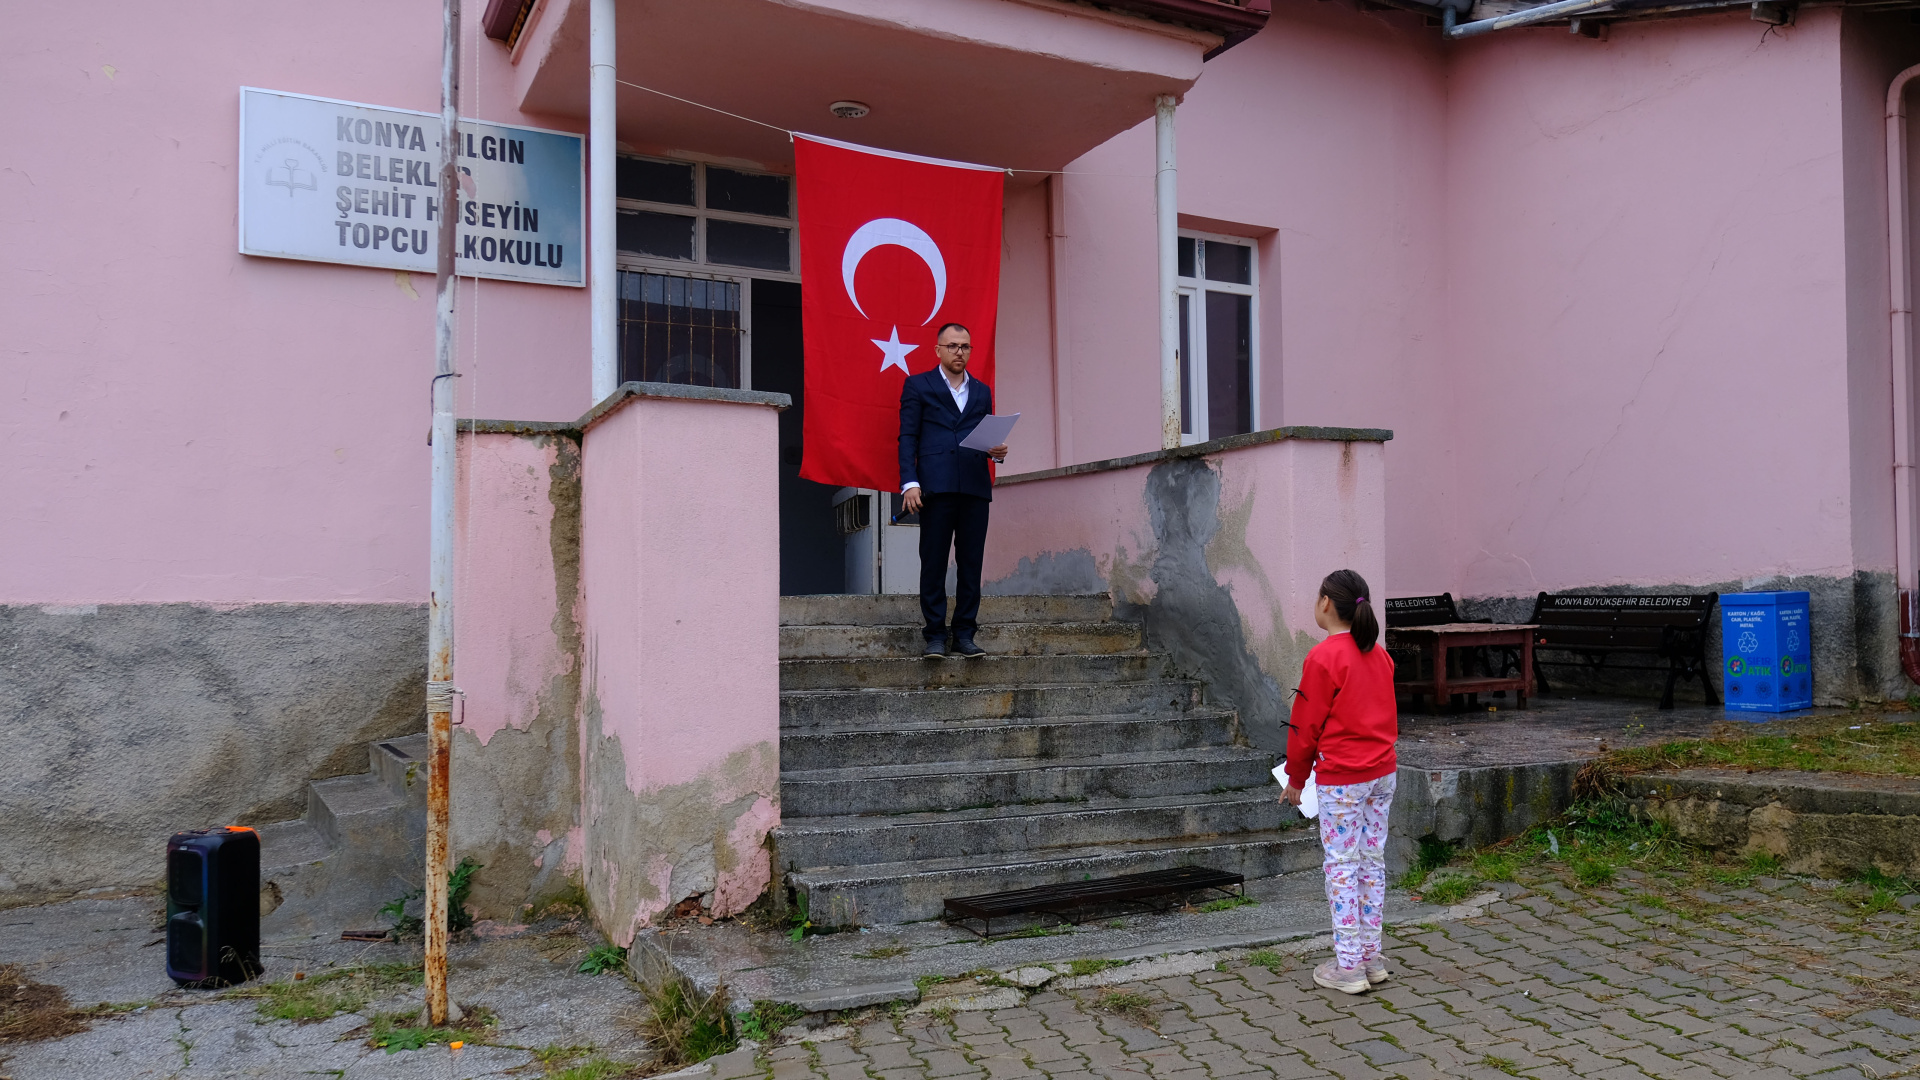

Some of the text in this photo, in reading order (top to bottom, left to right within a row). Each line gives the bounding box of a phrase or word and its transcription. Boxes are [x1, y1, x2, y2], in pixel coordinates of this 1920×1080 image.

[336, 116, 427, 152] KONYA
[336, 151, 471, 191] BELEKL
[335, 185, 539, 233] ŞEHİT HSEYİN
[334, 220, 563, 269] TOPCU KOKULU
[1395, 597, 1437, 608] BELEDİYESİ
[1555, 596, 1692, 607] KONYA BÜYÜKŞEHİR BELEDİYESİ
[1747, 666, 1772, 676] ATIK
